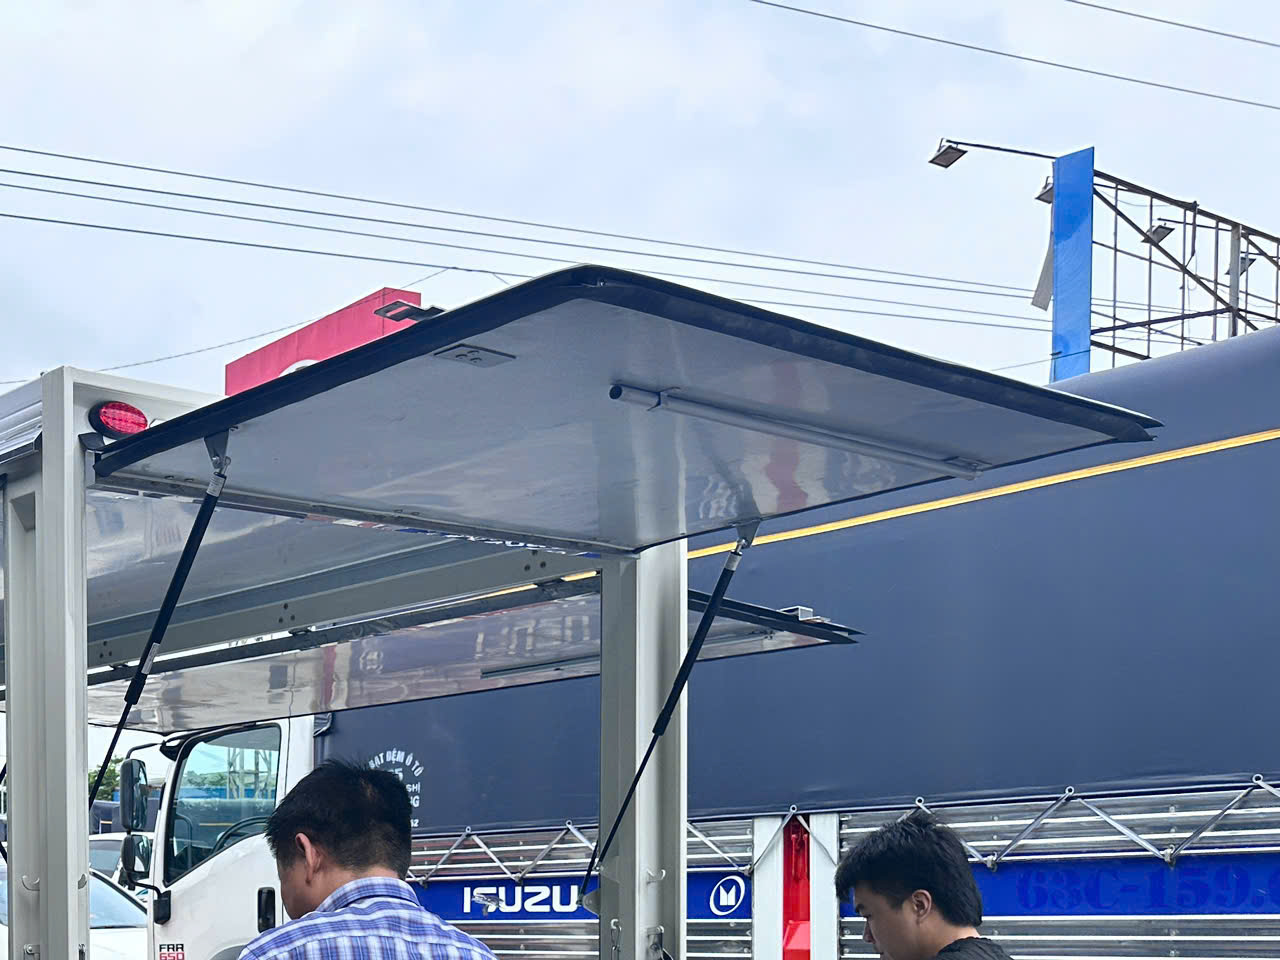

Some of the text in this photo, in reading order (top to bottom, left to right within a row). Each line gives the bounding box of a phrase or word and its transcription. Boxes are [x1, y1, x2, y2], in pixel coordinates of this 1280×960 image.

[463, 885, 579, 913] ISUZU
[159, 943, 184, 952] FRR
[159, 952, 185, 960] 650
